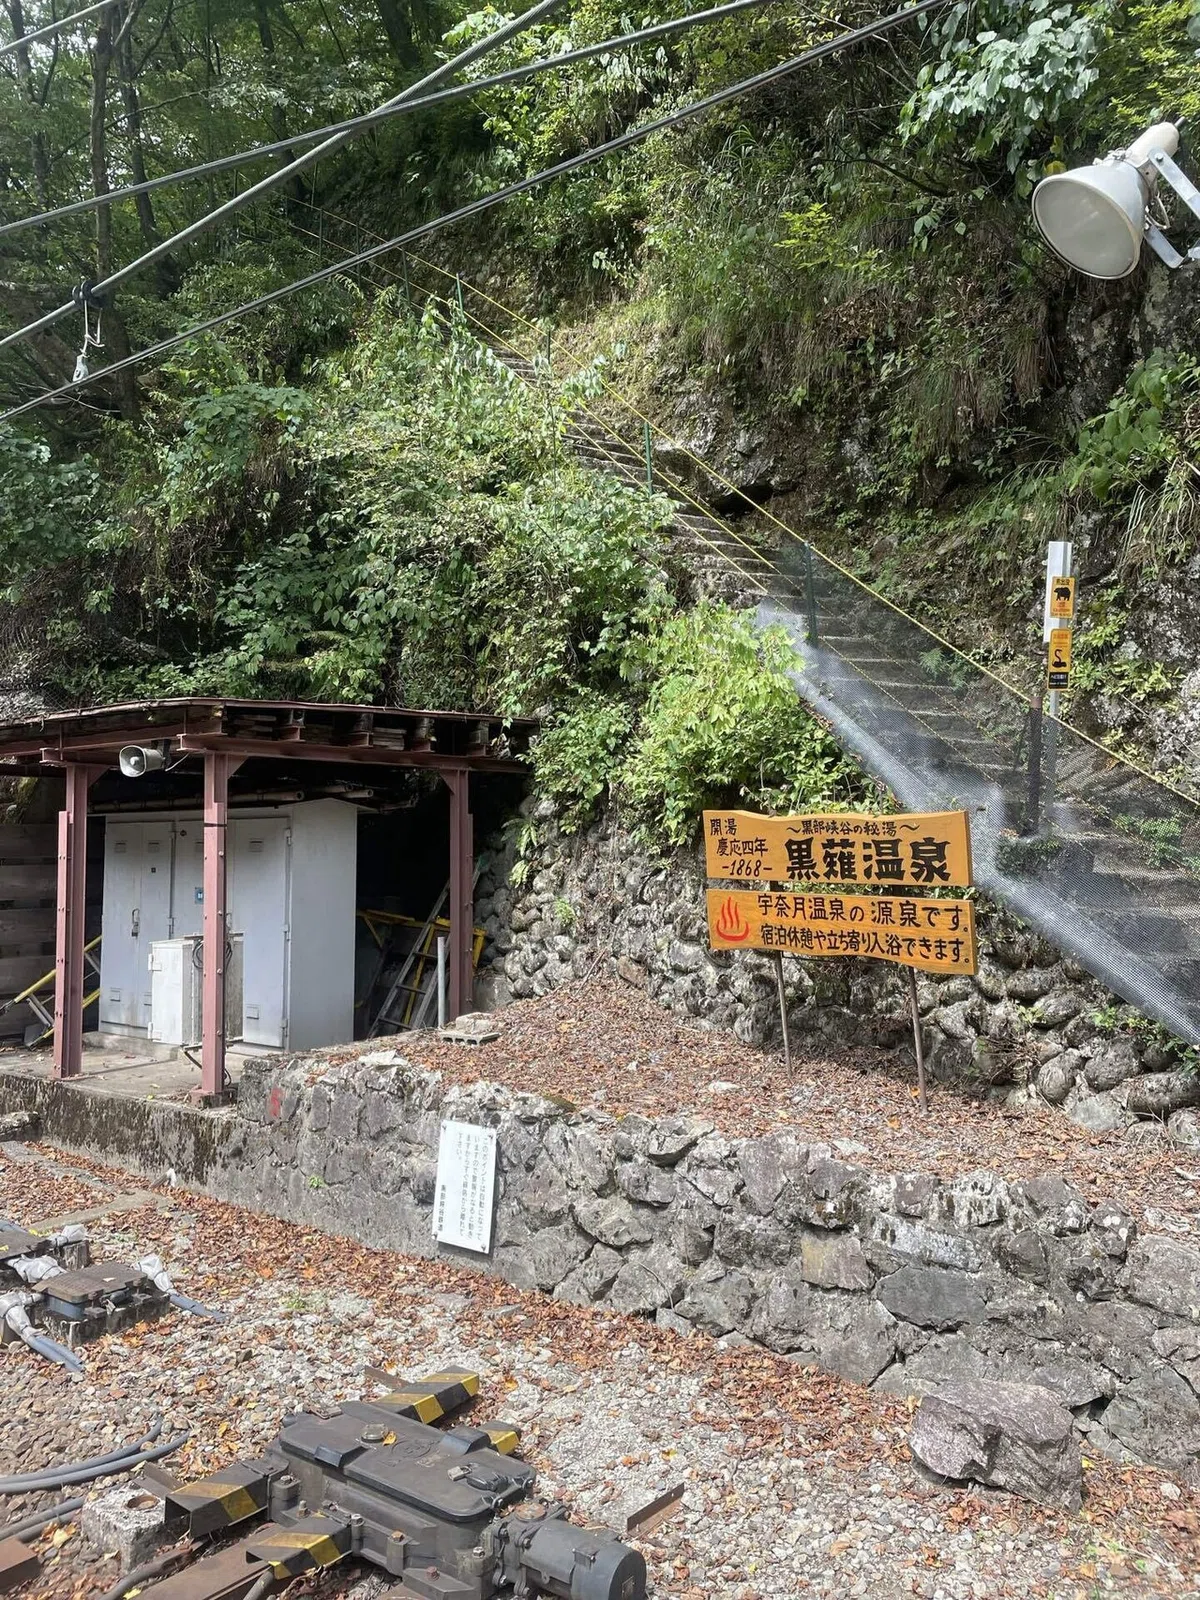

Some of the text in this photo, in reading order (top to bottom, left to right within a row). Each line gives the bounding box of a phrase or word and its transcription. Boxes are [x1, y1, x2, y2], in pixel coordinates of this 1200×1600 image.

[710, 818, 737, 836] 開湯
[716, 838, 768, 857] 慶応四年
[784, 837, 951, 882] 黒薙温泉
[757, 894, 969, 933] 宇奈月温泉の源泉です。
[761, 923, 970, 964] 宿泊休憩や立ち寄り入浴できます。
